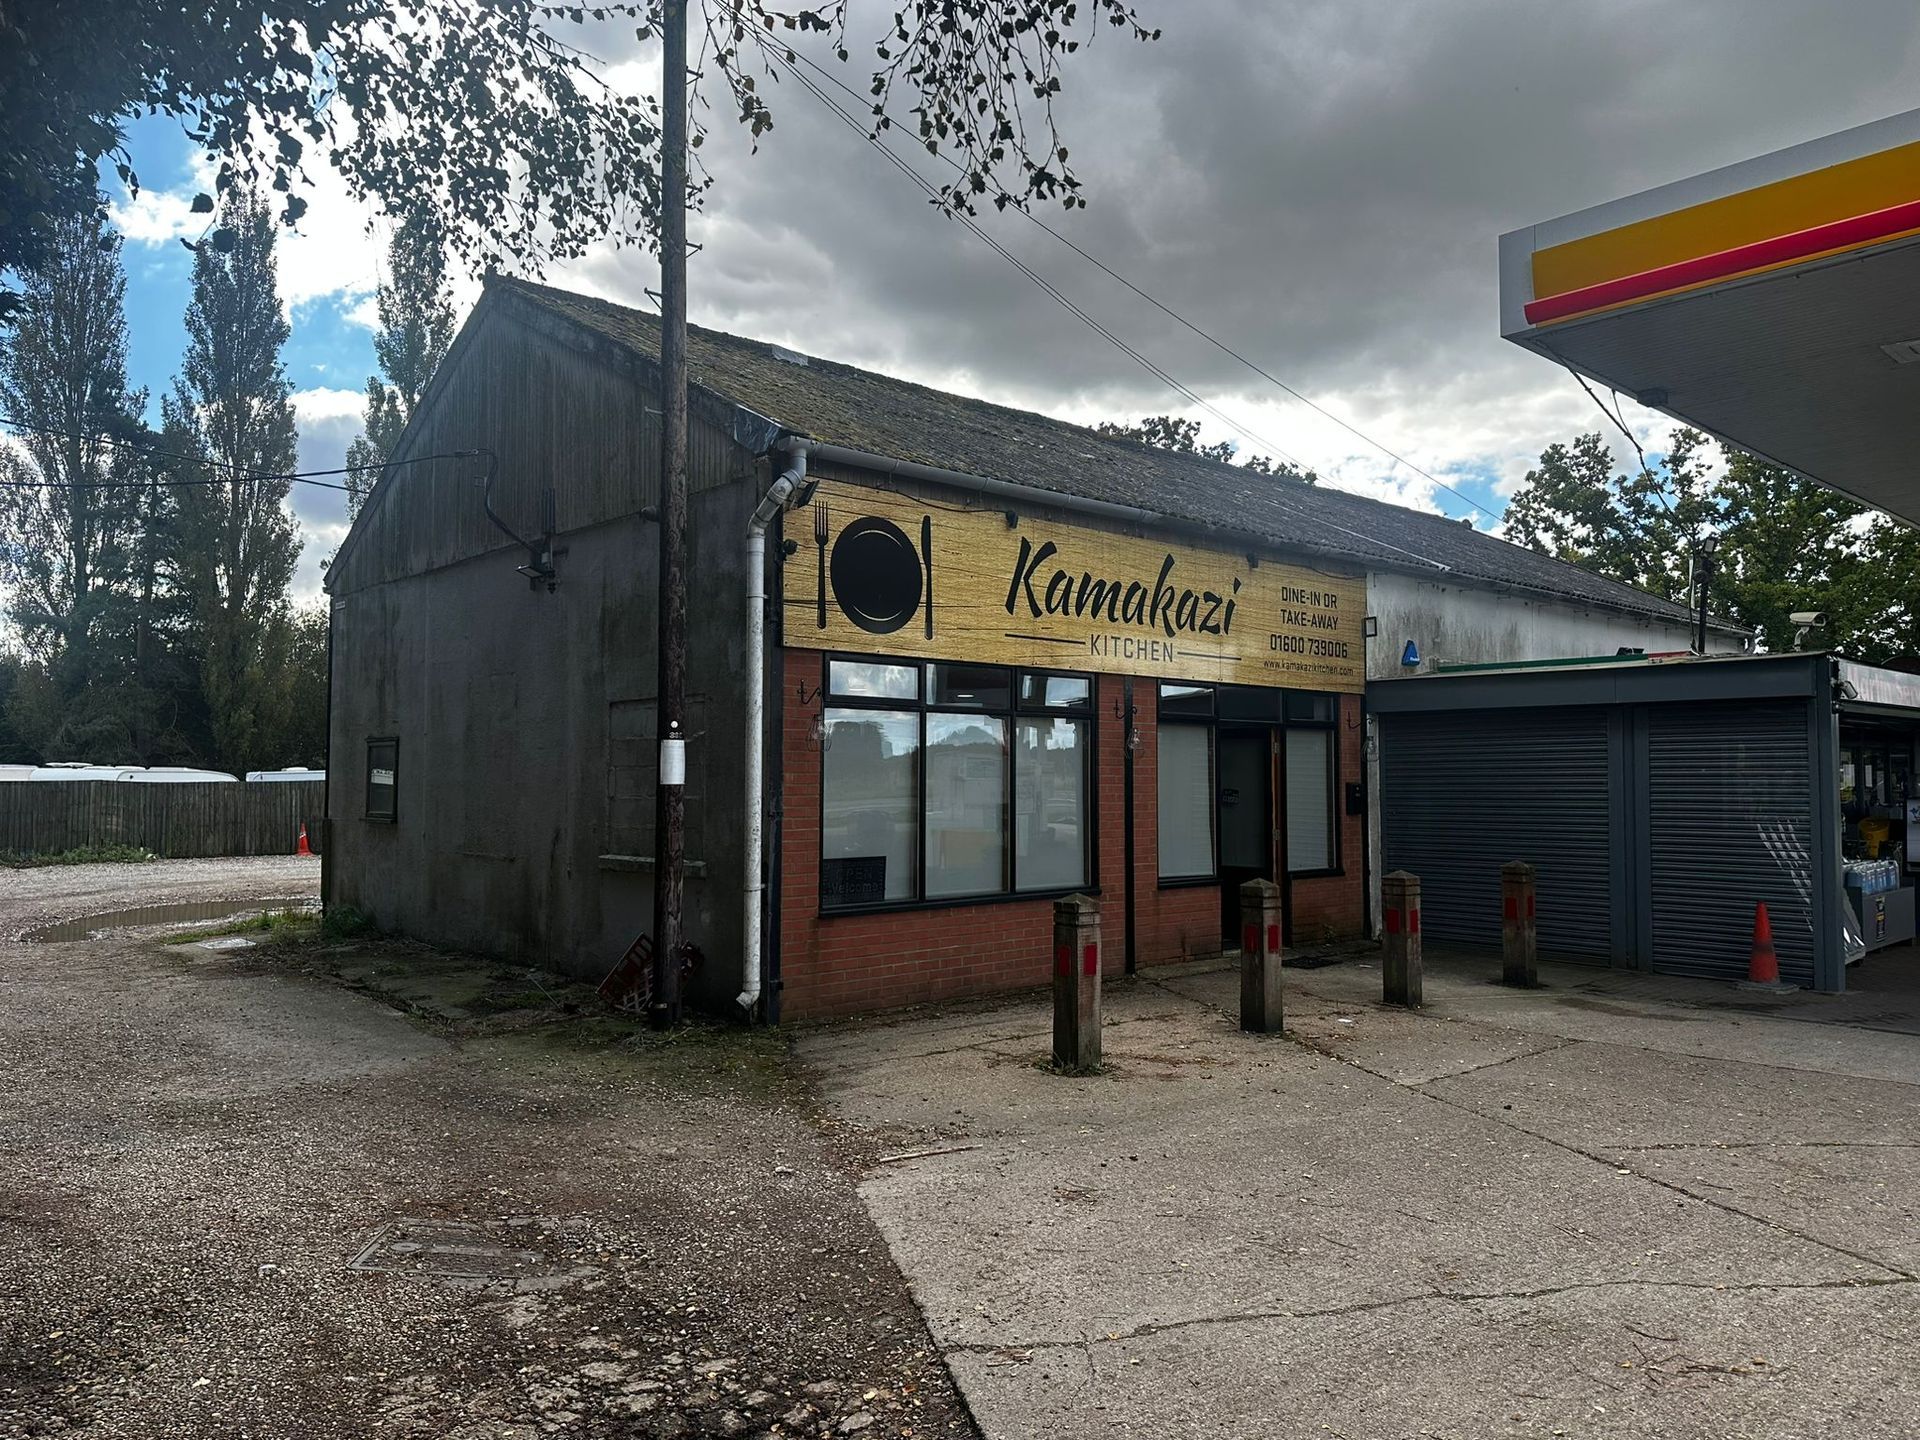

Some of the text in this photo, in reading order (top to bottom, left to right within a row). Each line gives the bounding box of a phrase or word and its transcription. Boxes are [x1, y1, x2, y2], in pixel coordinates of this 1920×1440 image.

[1005, 536, 1241, 637] Kamakazi
[1281, 586, 1337, 608] DINE-IN OR
[1281, 609, 1338, 630] TAKE-AWAY
[1090, 633, 1174, 663] KITCHEN
[1270, 634, 1348, 659] 01600 739006
[1264, 660, 1353, 676] www.kamakazikitchen.com
